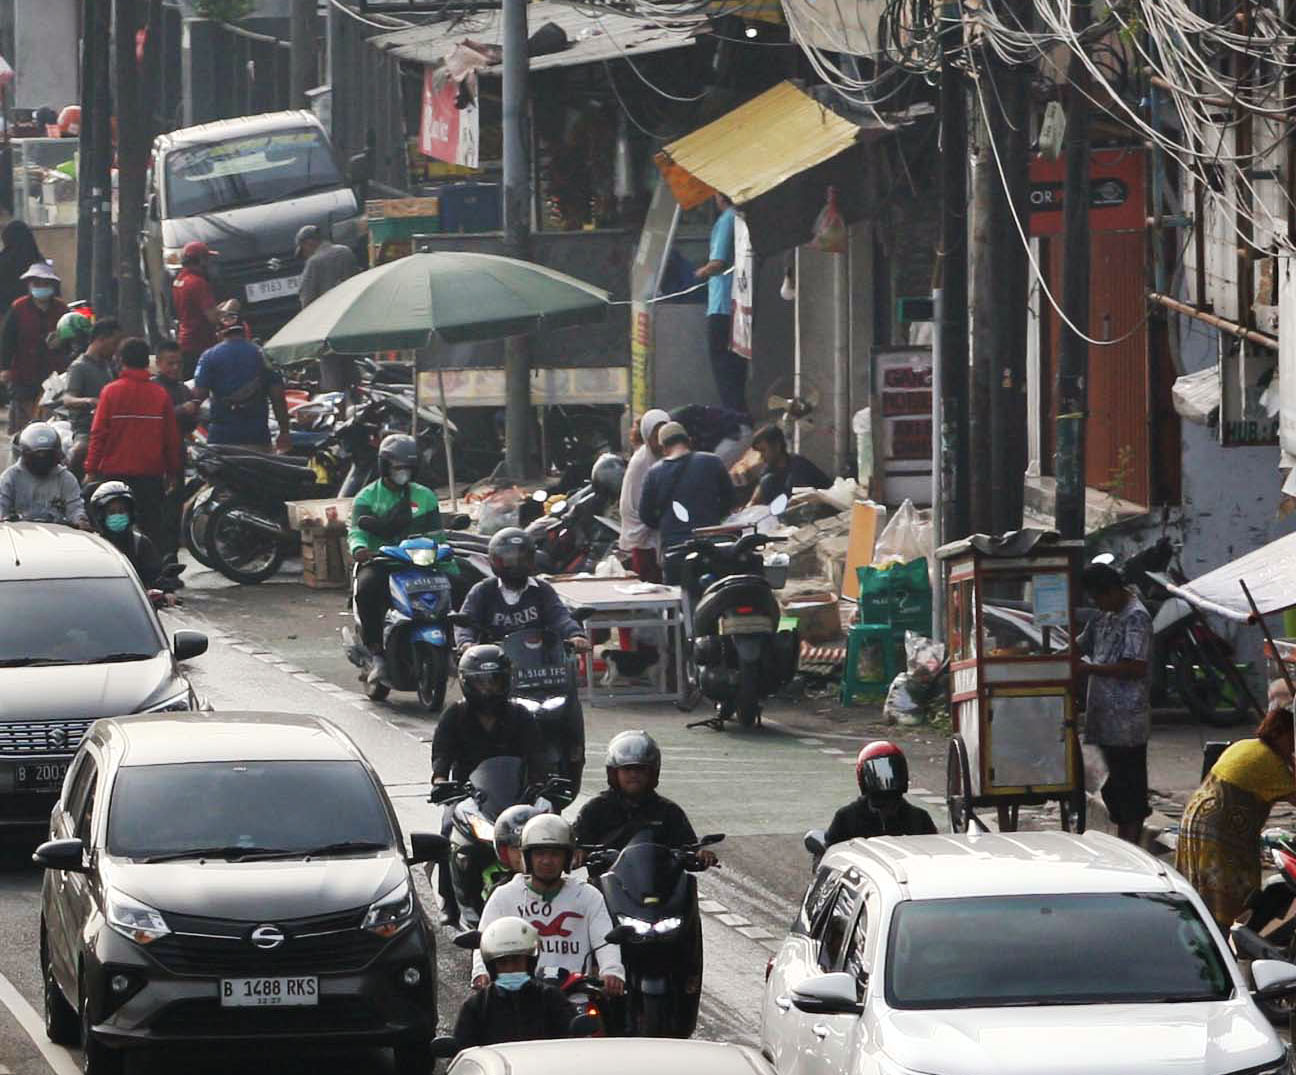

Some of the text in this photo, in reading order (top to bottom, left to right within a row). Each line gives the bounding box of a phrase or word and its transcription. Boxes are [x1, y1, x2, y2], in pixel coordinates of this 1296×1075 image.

[495, 606, 539, 626] PARIS
[19, 766, 26, 781] B
[539, 939, 579, 955] ALIBU
[224, 978, 316, 997] B 1488 RKS
